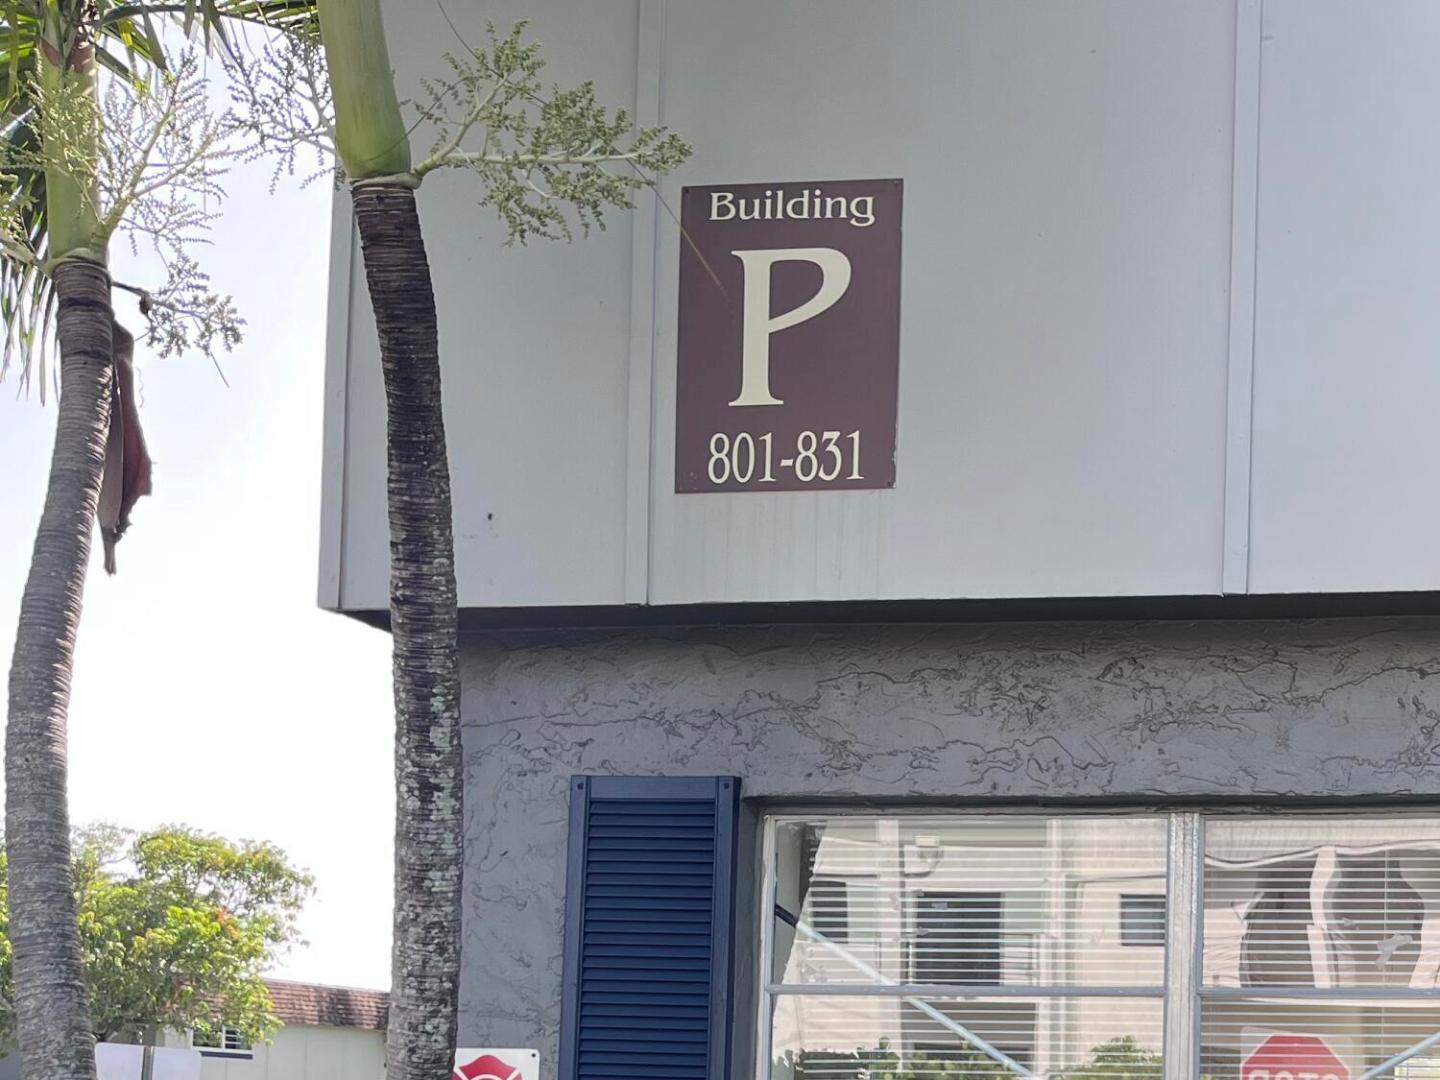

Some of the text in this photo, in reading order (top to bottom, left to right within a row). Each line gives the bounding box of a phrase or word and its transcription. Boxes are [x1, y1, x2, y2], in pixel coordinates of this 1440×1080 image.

[708, 188, 876, 227] Building
[728, 247, 852, 407] P
[707, 430, 865, 484] 801-831
